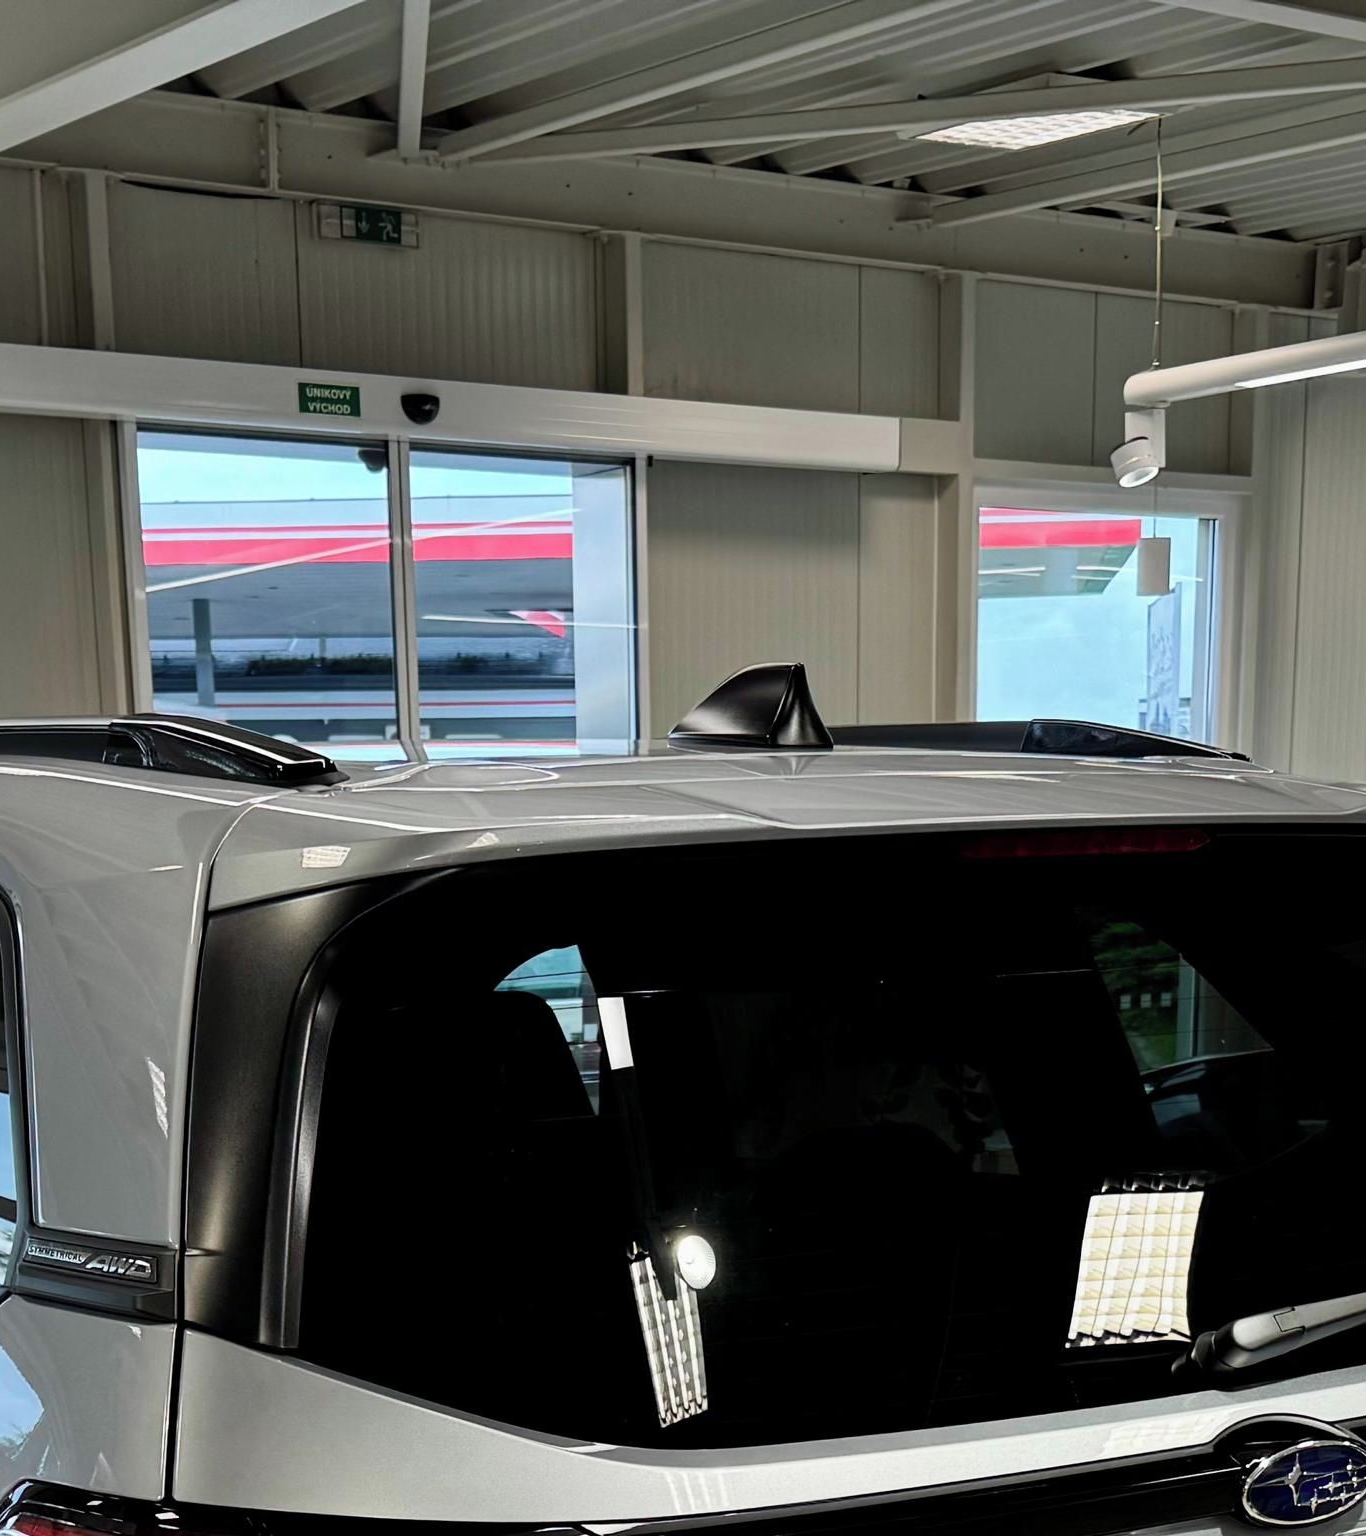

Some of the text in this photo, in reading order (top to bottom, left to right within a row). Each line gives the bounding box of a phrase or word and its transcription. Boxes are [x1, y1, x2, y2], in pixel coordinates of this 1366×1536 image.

[306, 385, 352, 400] ÚNIKOVÝ
[308, 401, 351, 414] VÝCHOD
[28, 1243, 153, 1278] SYMMETRICAL AWD
